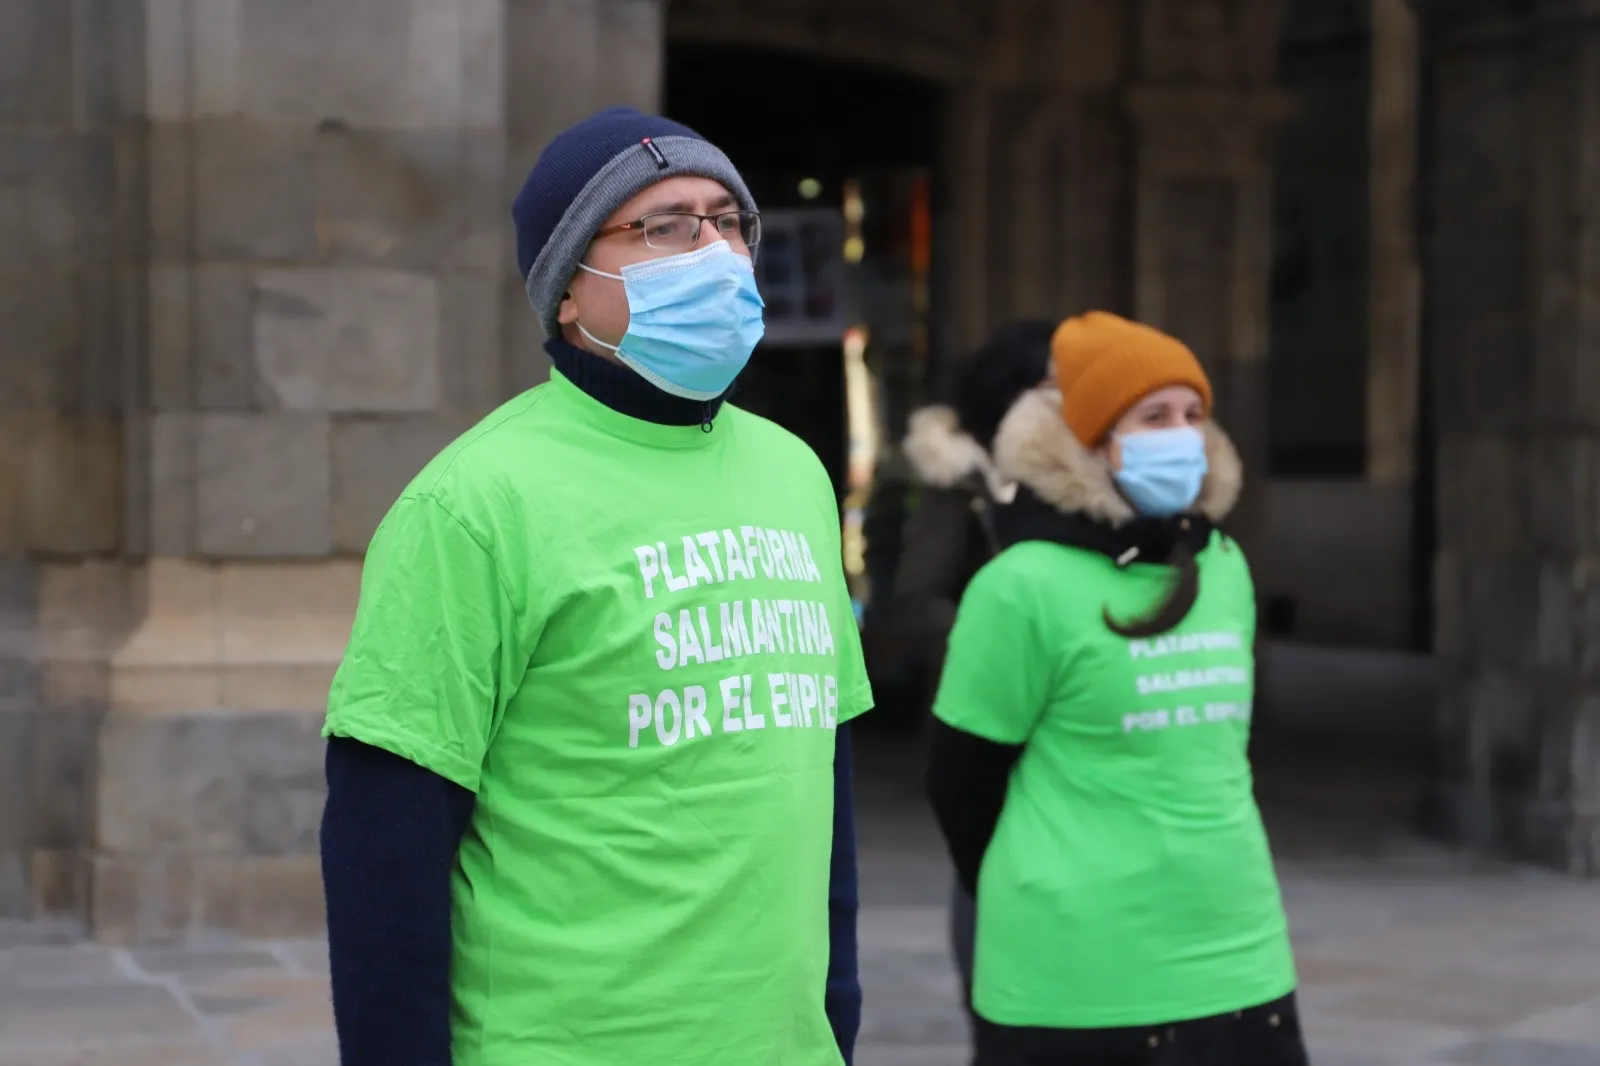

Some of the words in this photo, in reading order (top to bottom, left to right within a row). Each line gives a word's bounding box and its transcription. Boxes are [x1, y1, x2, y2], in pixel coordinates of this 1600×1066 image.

[634, 526, 821, 599] PLATAFORMA
[654, 598, 834, 670] SALMANTINA
[628, 685, 712, 748] POR
[719, 675, 765, 732] EL
[1122, 709, 1170, 733] POR
[1174, 705, 1200, 725] EL
